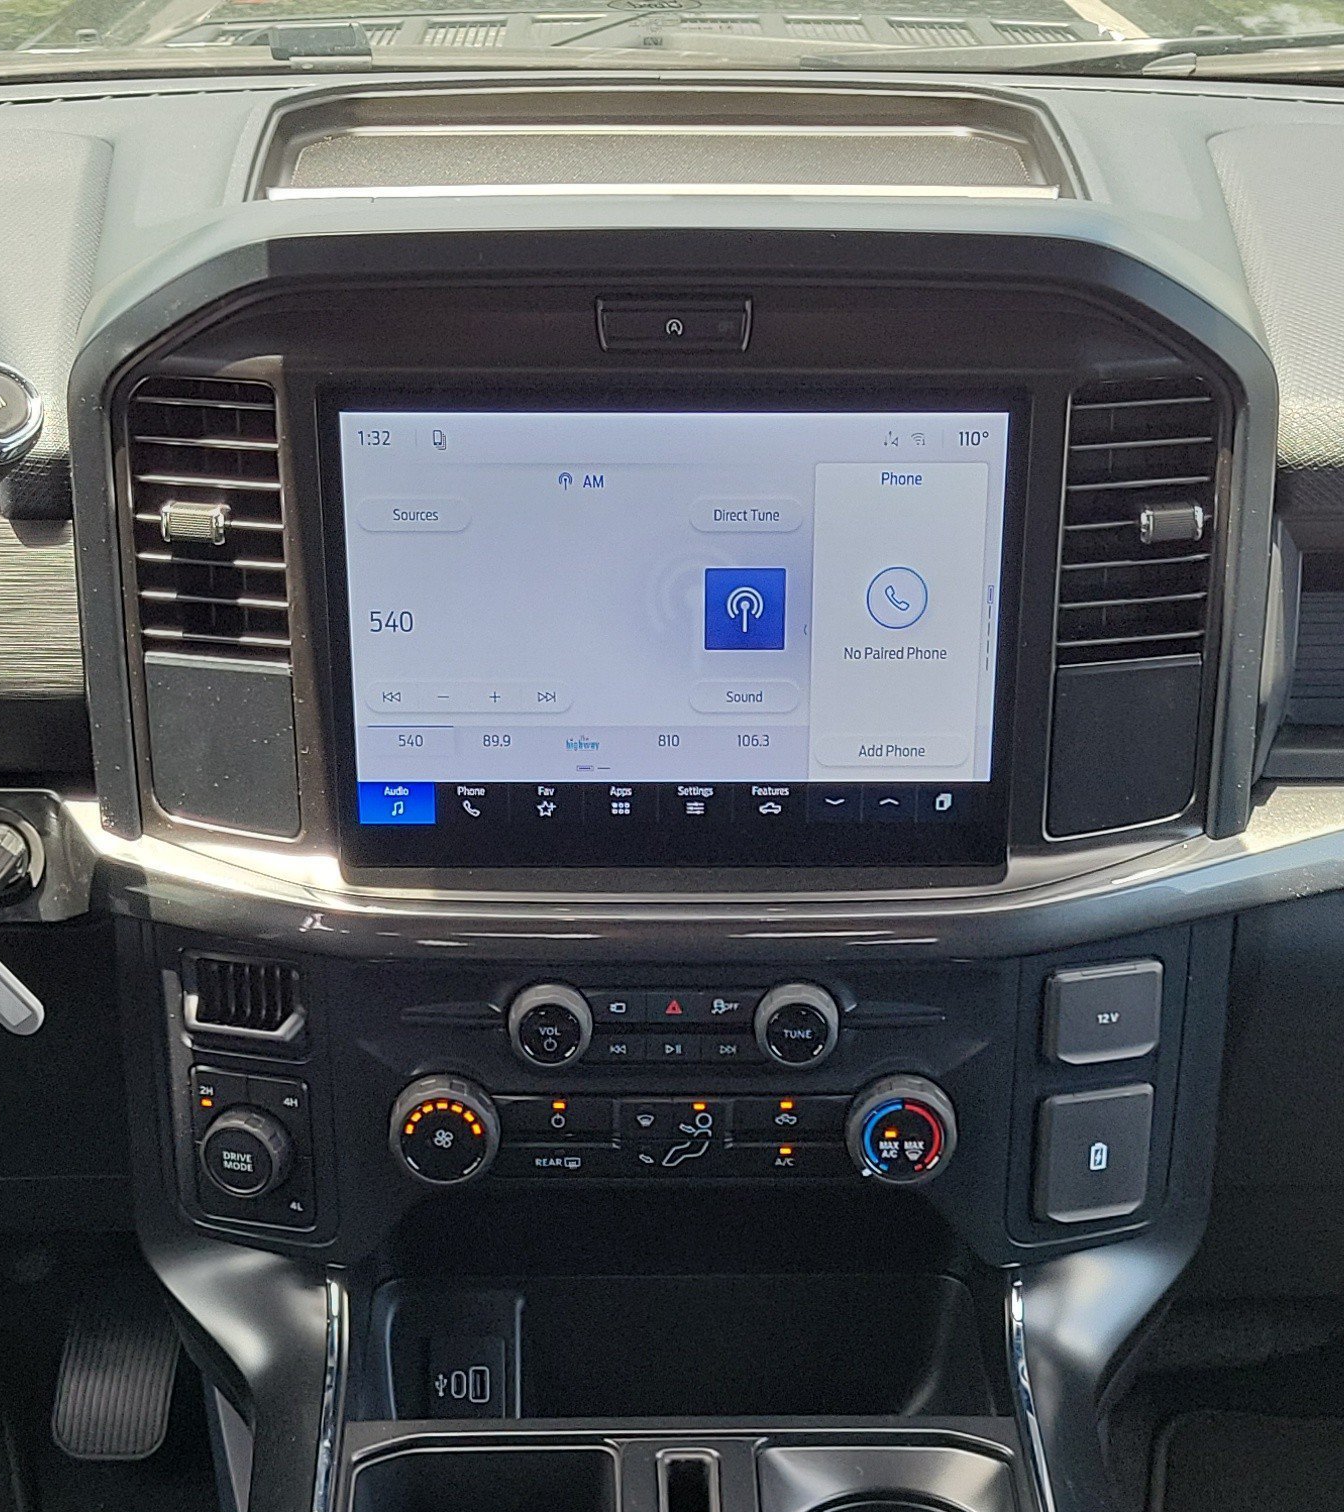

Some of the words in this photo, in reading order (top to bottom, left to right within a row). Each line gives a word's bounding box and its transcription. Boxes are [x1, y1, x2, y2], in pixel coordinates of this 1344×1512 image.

[357, 430, 391, 446] 1:32
[959, 430, 990, 447] 110°
[583, 474, 604, 488] AM
[881, 472, 923, 486] Phone
[393, 508, 439, 521] Sources
[713, 509, 748, 522] Direct
[750, 509, 780, 522] Tune
[369, 611, 413, 633] 540
[844, 647, 862, 660] No
[864, 646, 904, 660] Paired
[907, 646, 948, 660] Phone
[726, 690, 763, 703] Sound
[398, 734, 423, 747] 540
[483, 734, 511, 747] 89.9
[658, 735, 680, 747] 810
[737, 735, 770, 747] 106.3
[858, 745, 883, 757] Add
[886, 745, 926, 757] Phone
[384, 786, 409, 796] Audio
[457, 786, 486, 796] Phone
[538, 786, 555, 796] Fav
[610, 786, 632, 799] Apps
[678, 786, 714, 798] Settings
[752, 786, 789, 797] Features
[725, 1002, 740, 1011] OFF
[1097, 1012, 1119, 1024] 12V
[539, 1026, 561, 1036] VOL
[784, 1029, 813, 1039] TUNE
[200, 1086, 214, 1096] 2H
[283, 1098, 298, 1108] 4H
[879, 1141, 899, 1150] MAX
[904, 1141, 925, 1150] MAX
[222, 1151, 252, 1163] DRIVE
[881, 1149, 898, 1159] A/C
[223, 1160, 253, 1173] MODE
[535, 1158, 562, 1167] REAR
[775, 1157, 794, 1167] A/C
[290, 1201, 304, 1212] 4L
